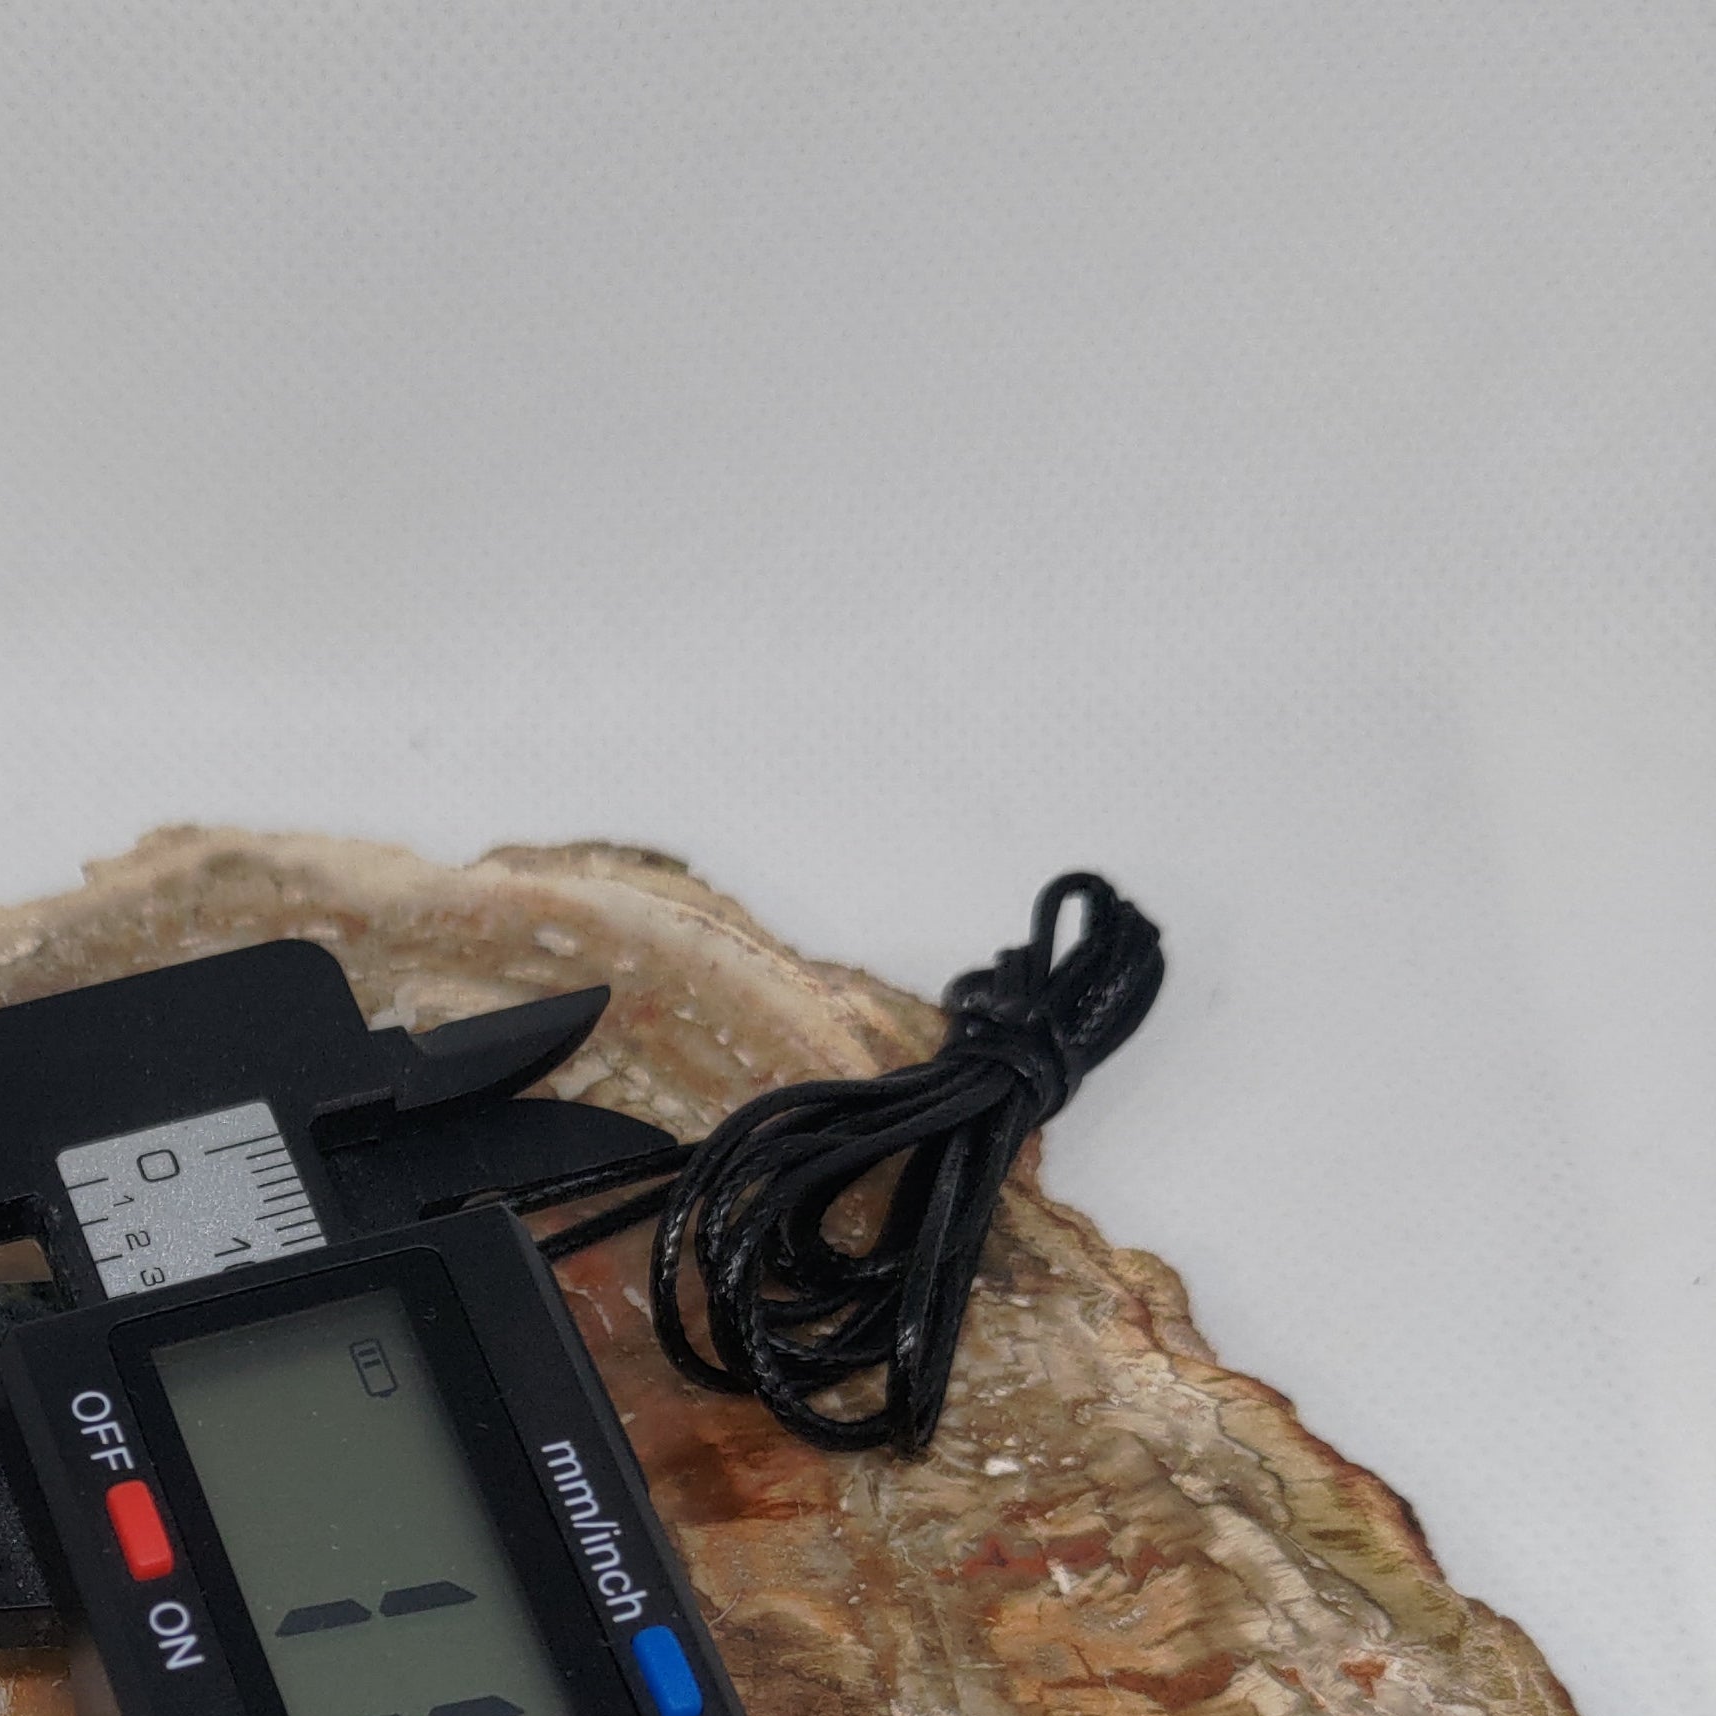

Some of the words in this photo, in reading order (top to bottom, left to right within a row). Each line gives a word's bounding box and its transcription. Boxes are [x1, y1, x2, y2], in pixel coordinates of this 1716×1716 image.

[113, 1195, 134, 1207] 1
[126, 1230, 151, 1250] 2
[141, 1267, 165, 1287] 3
[137, 1149, 180, 1182] 0
[214, 1237, 256, 1272] 1
[72, 1390, 134, 1471] OFF
[541, 1440, 648, 1623] mm/inch
[148, 1602, 205, 1670] ON
